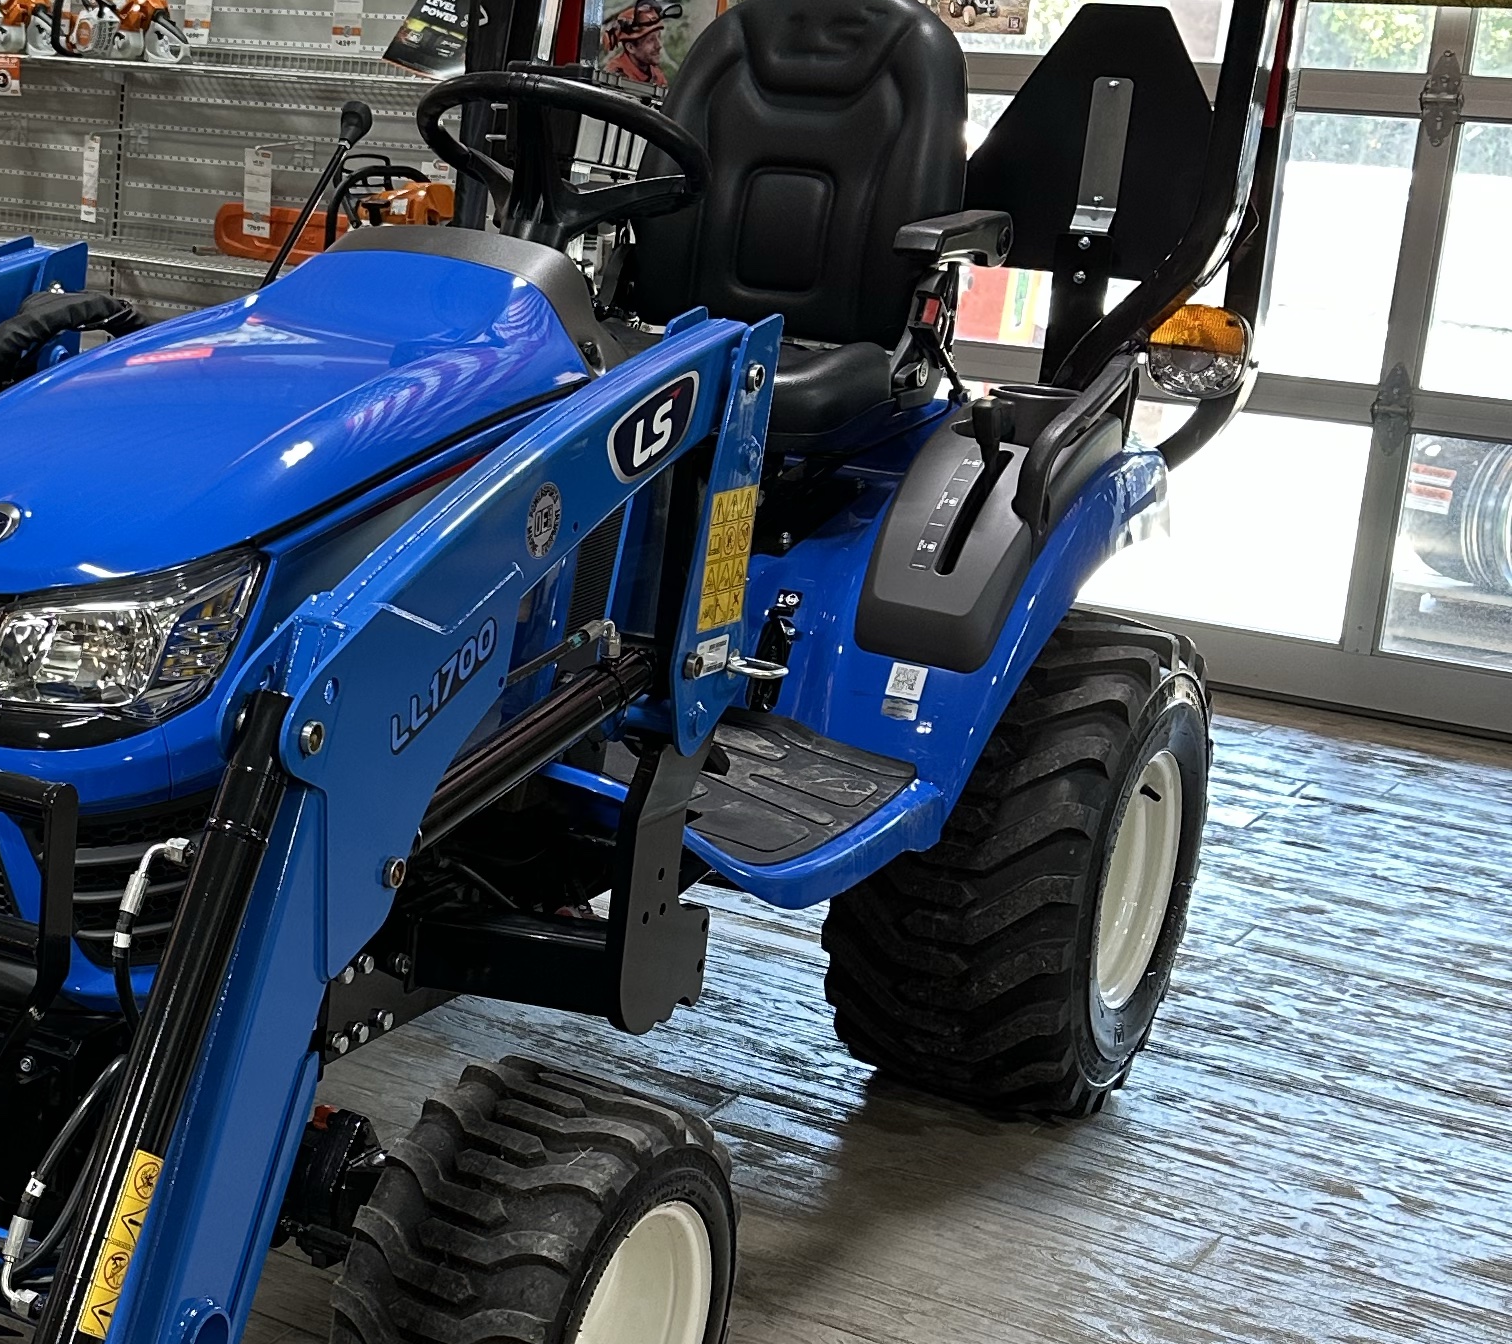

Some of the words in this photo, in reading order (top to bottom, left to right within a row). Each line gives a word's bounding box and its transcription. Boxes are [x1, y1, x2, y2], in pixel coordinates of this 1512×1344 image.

[420, 5, 459, 24] POWER
[632, 393, 676, 468] LS
[390, 616, 497, 755] LL1700
